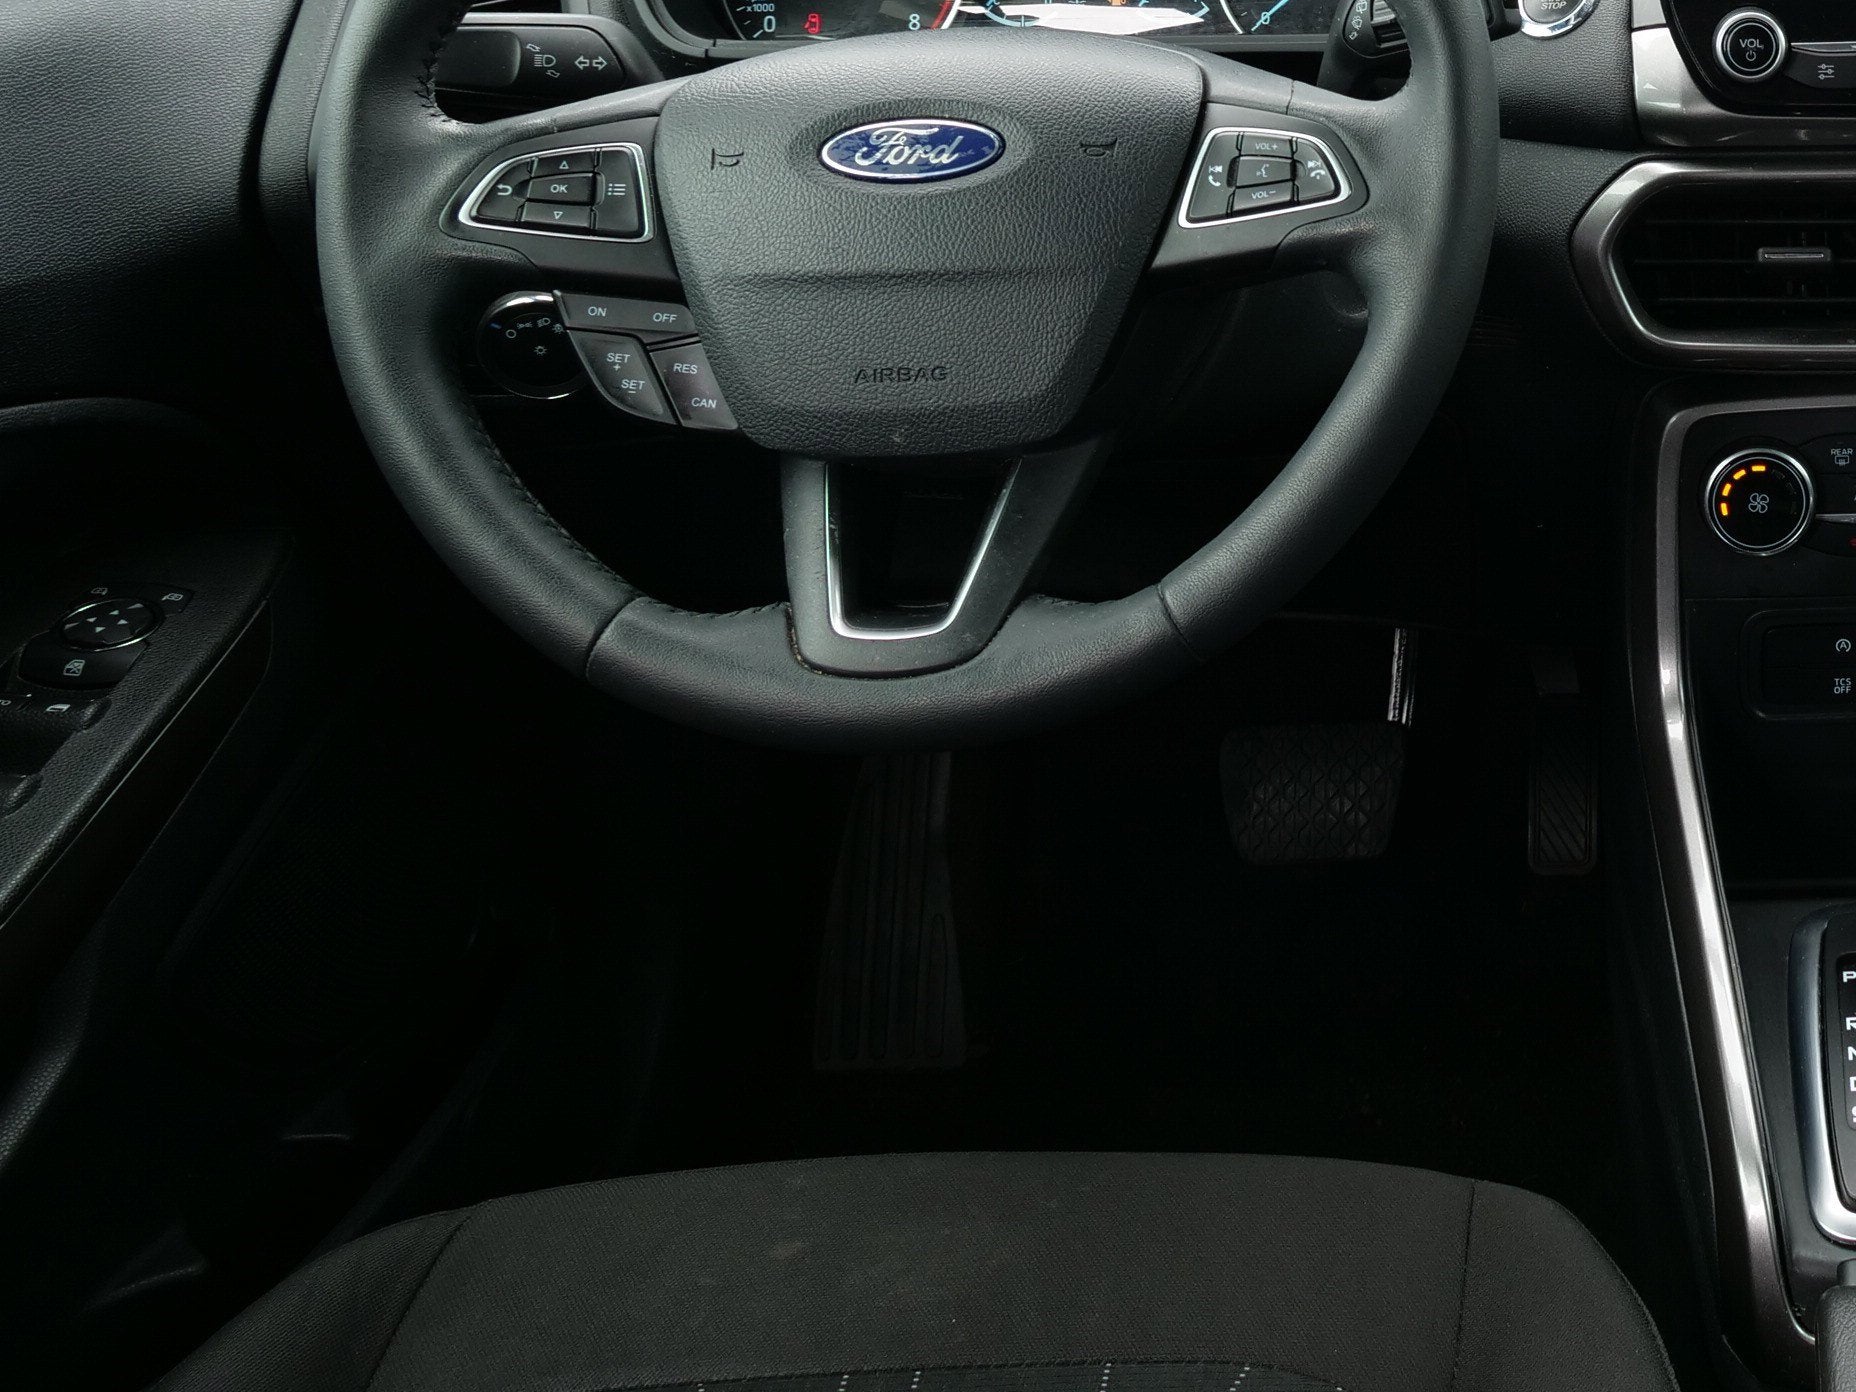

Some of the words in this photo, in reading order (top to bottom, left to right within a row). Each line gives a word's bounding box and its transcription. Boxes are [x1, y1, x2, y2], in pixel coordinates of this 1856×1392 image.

[746, 3, 775, 12] x1000
[1540, 1, 1567, 11] STOP
[763, 15, 776, 32] 0
[908, 13, 920, 31] 8
[1739, 37, 1764, 50] VOL
[854, 126, 964, 166] Ford
[550, 184, 568, 194] OK
[587, 306, 607, 317] ON
[652, 312, 677, 324] OFF
[606, 352, 631, 364] SET
[673, 362, 698, 375] RES
[853, 365, 949, 385] AIRBAG
[621, 379, 645, 390] SET
[691, 397, 717, 408] CAN
[1830, 448, 1854, 456] REAR
[1833, 677, 1852, 686] TCS
[1833, 686, 1852, 694] OFF
